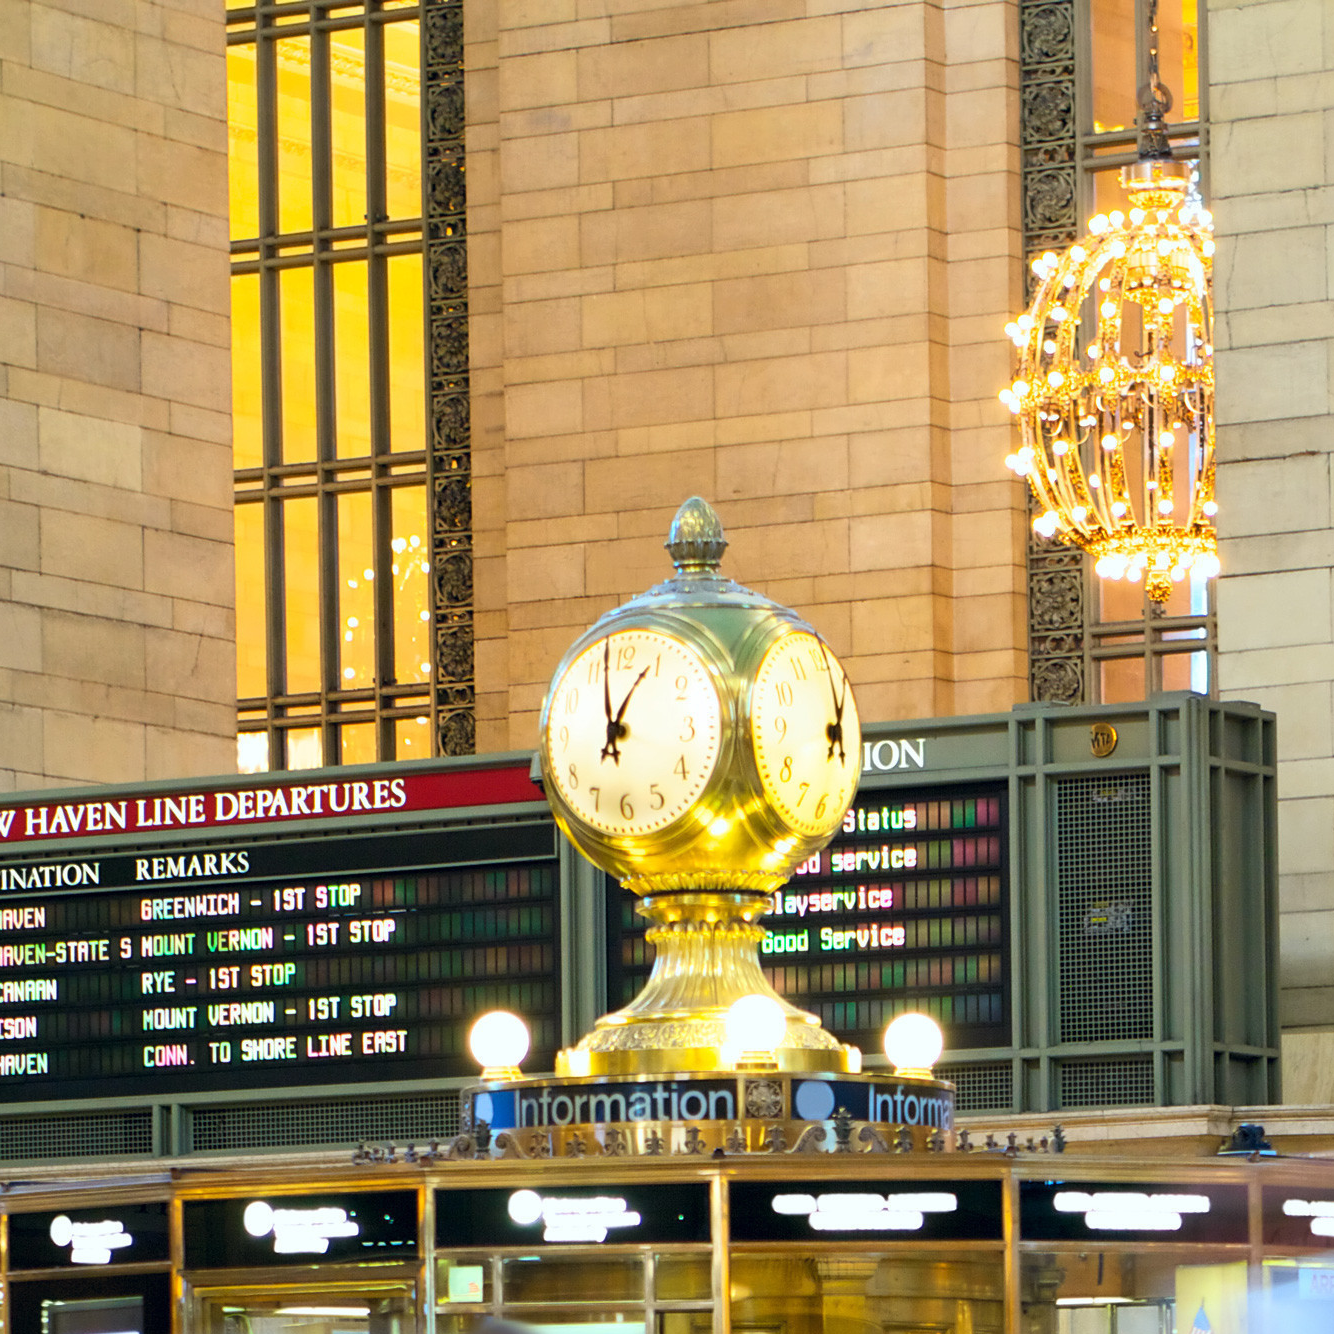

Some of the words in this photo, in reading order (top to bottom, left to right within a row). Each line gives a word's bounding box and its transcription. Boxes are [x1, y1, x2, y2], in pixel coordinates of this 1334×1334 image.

[588, 660, 601, 684] 11
[616, 646, 636, 671] 12
[655, 653, 661, 677] 1
[790, 657, 807, 680] 11
[675, 675, 688, 700] 2
[776, 681, 793, 707] 10
[680, 716, 695, 742] 3
[775, 716, 787, 744] 9
[673, 754, 690, 780] 4
[863, 738, 926, 771] ION
[569, 763, 578, 789] 8
[780, 756, 792, 782] 8
[25, 801, 127, 836] HAVEN
[135, 795, 206, 827] LINE
[214, 778, 406, 821] DEPARTURES
[589, 787, 600, 812] 7
[620, 793, 634, 820] 6
[650, 784, 665, 810] 5
[797, 782, 810, 807] 7
[815, 794, 829, 819] 6
[843, 806, 917, 833] Status
[135, 851, 250, 881] REMARKS
[831, 846, 917, 873] service
[140, 893, 240, 921] GREENWICH
[273, 887, 305, 911] 1ST
[315, 883, 361, 909] STOP
[764, 885, 893, 917] layservice
[120, 937, 132, 959] S
[141, 932, 196, 957] MOUNT
[207, 927, 273, 952] VERNON
[306, 922, 339, 947] 1ST
[349, 919, 396, 943] STOP
[762, 928, 809, 954] Good
[820, 924, 906, 951] Service
[141, 970, 176, 994] RYE
[209, 966, 240, 990] 1ST
[250, 963, 296, 987] STOP
[142, 1006, 197, 1031] MOUNT
[207, 1001, 274, 1026] VERNON
[308, 996, 340, 1021] 1ST
[350, 993, 397, 1018] STOP
[143, 1043, 196, 1068] CONN.
[209, 1042, 231, 1065] TO
[241, 1037, 297, 1061] SHORE
[306, 1033, 352, 1058] LINE
[361, 1030, 408, 1055] EAST
[515, 1084, 734, 1128] Information
[868, 1083, 954, 1130] Informa
